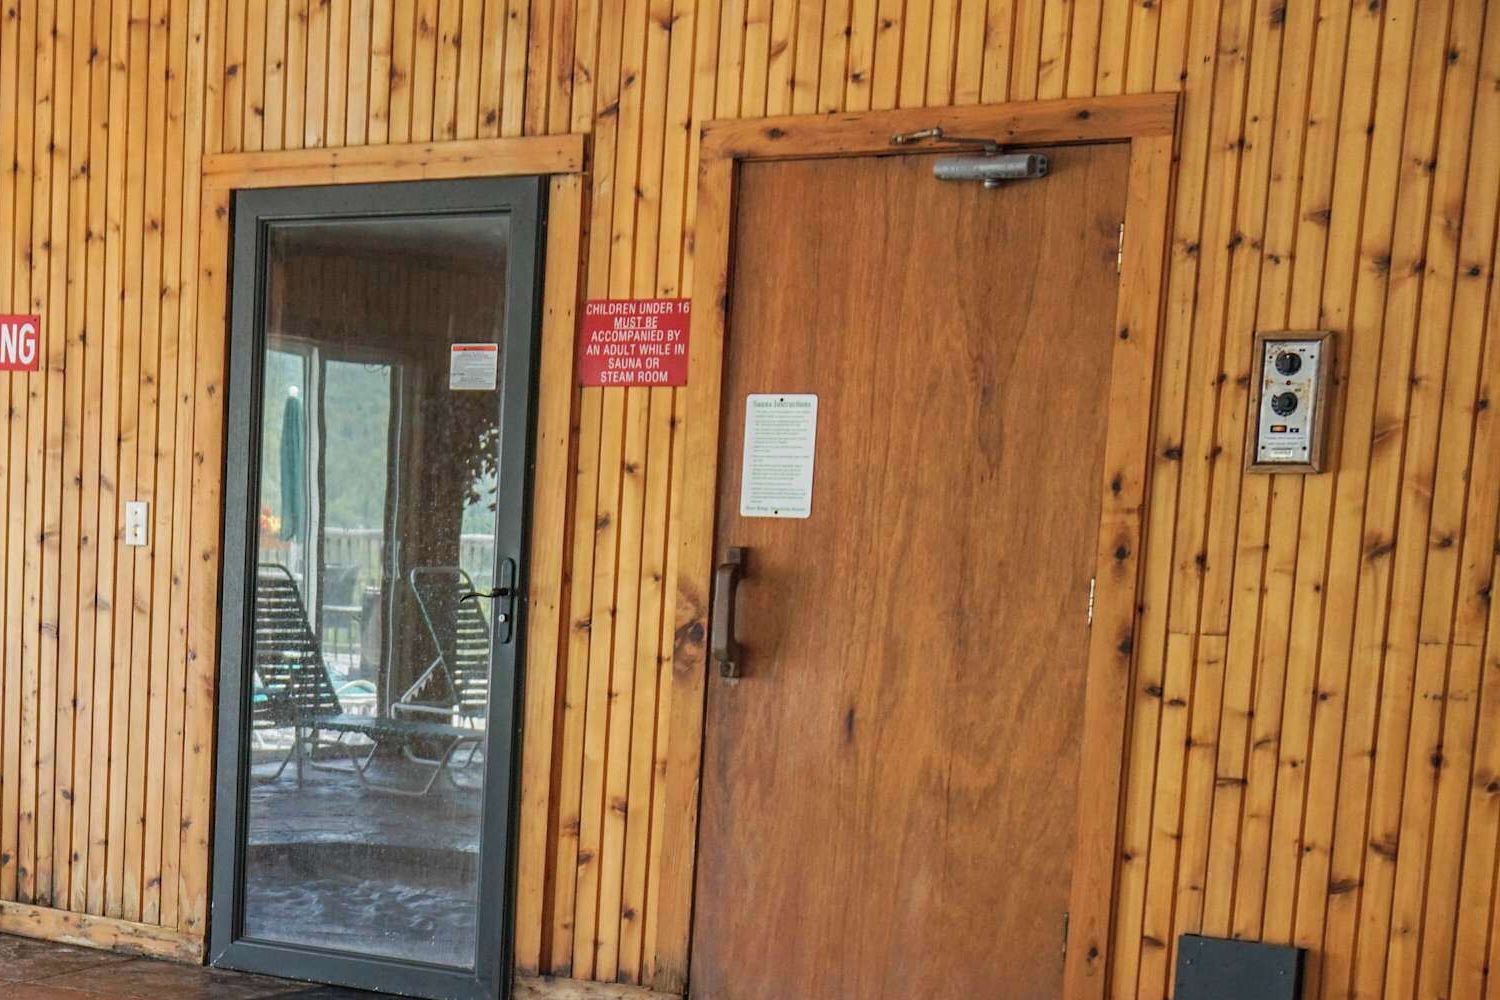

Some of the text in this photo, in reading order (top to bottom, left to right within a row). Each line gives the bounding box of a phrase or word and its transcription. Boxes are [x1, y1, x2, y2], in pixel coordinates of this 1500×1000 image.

[586, 302, 690, 315] CHILDREN UNDER 16
[614, 316, 658, 328] MUST BE
[591, 330, 681, 342] ACCOMPANIED BY
[586, 343, 685, 356] AN ADULT WHILE IN
[608, 357, 660, 369] SAUNA OR
[600, 371, 668, 383] STEAM ROOM
